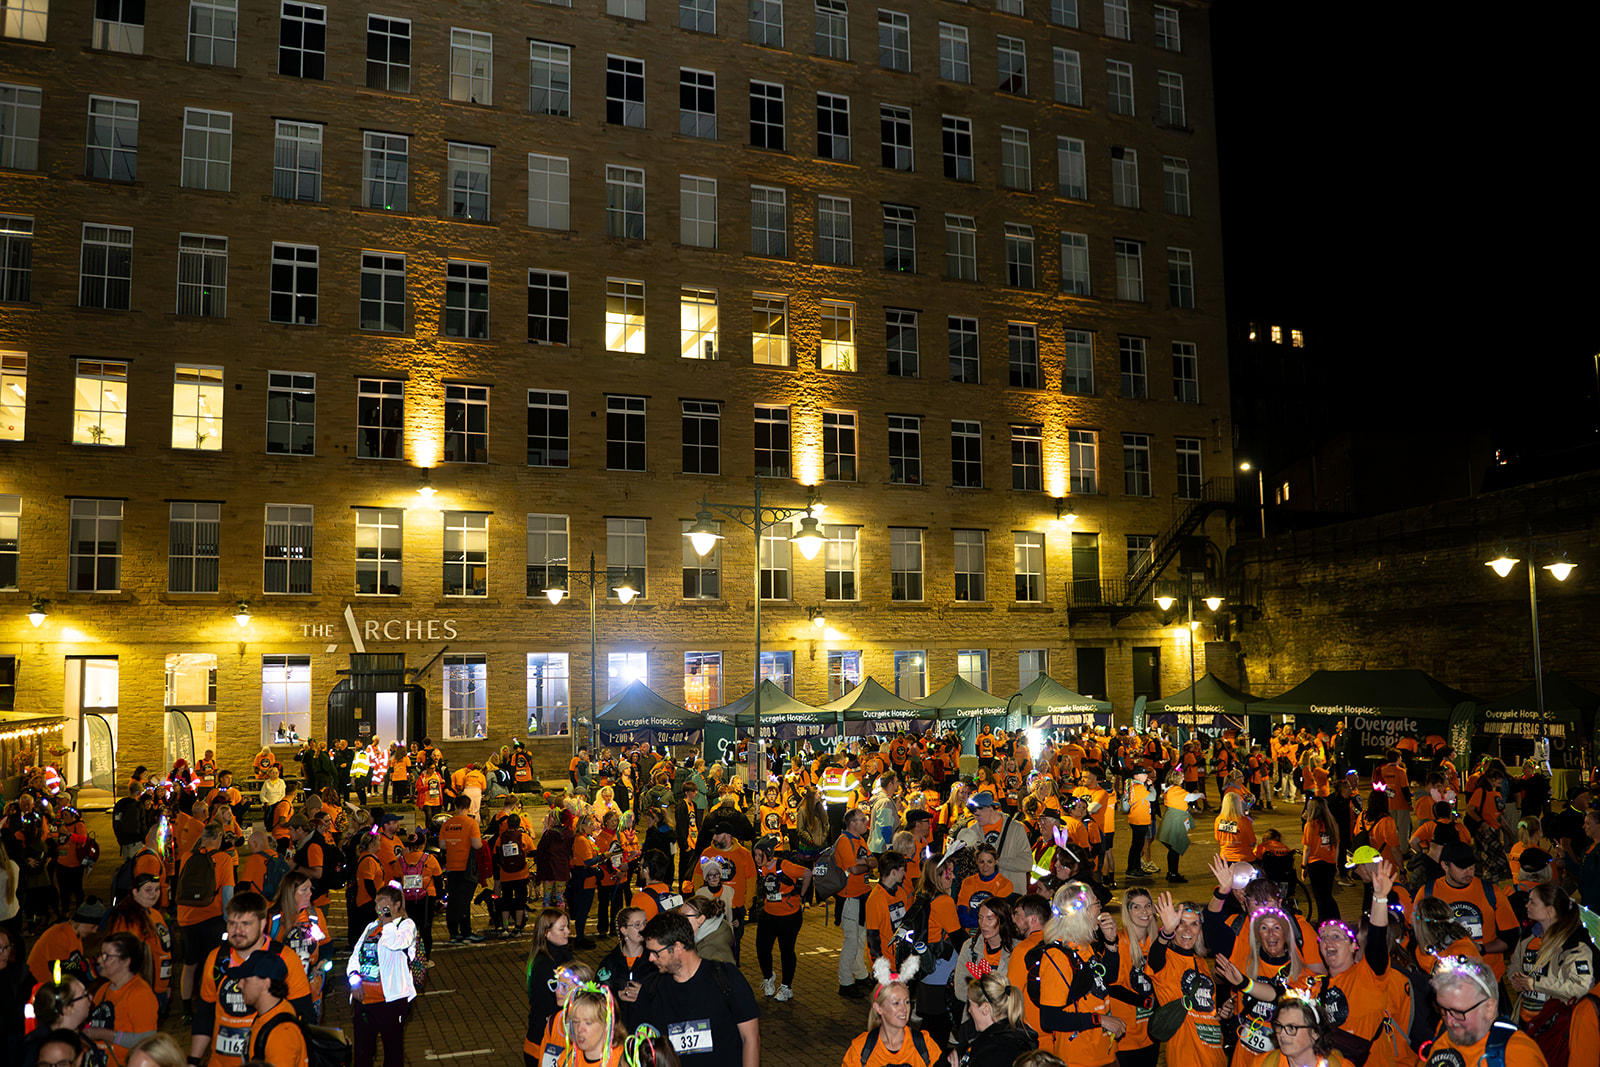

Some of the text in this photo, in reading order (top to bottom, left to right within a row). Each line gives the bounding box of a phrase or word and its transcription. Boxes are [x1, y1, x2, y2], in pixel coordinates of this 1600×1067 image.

[300, 624, 334, 637] THE
[957, 708, 983, 718] Overgate
[1164, 704, 1193, 712] Overgate
[1310, 704, 1375, 716] Overgate Hospice
[786, 713, 813, 723] Hospice
[863, 709, 916, 719] Overgate Hospice
[1485, 709, 1551, 720] Overgate Hospe
[617, 716, 677, 727] Overgate Hospice
[1354, 716, 1418, 735] Overgate
[1513, 722, 1548, 736] MESSAGS
[680, 1034, 700, 1049] 337
